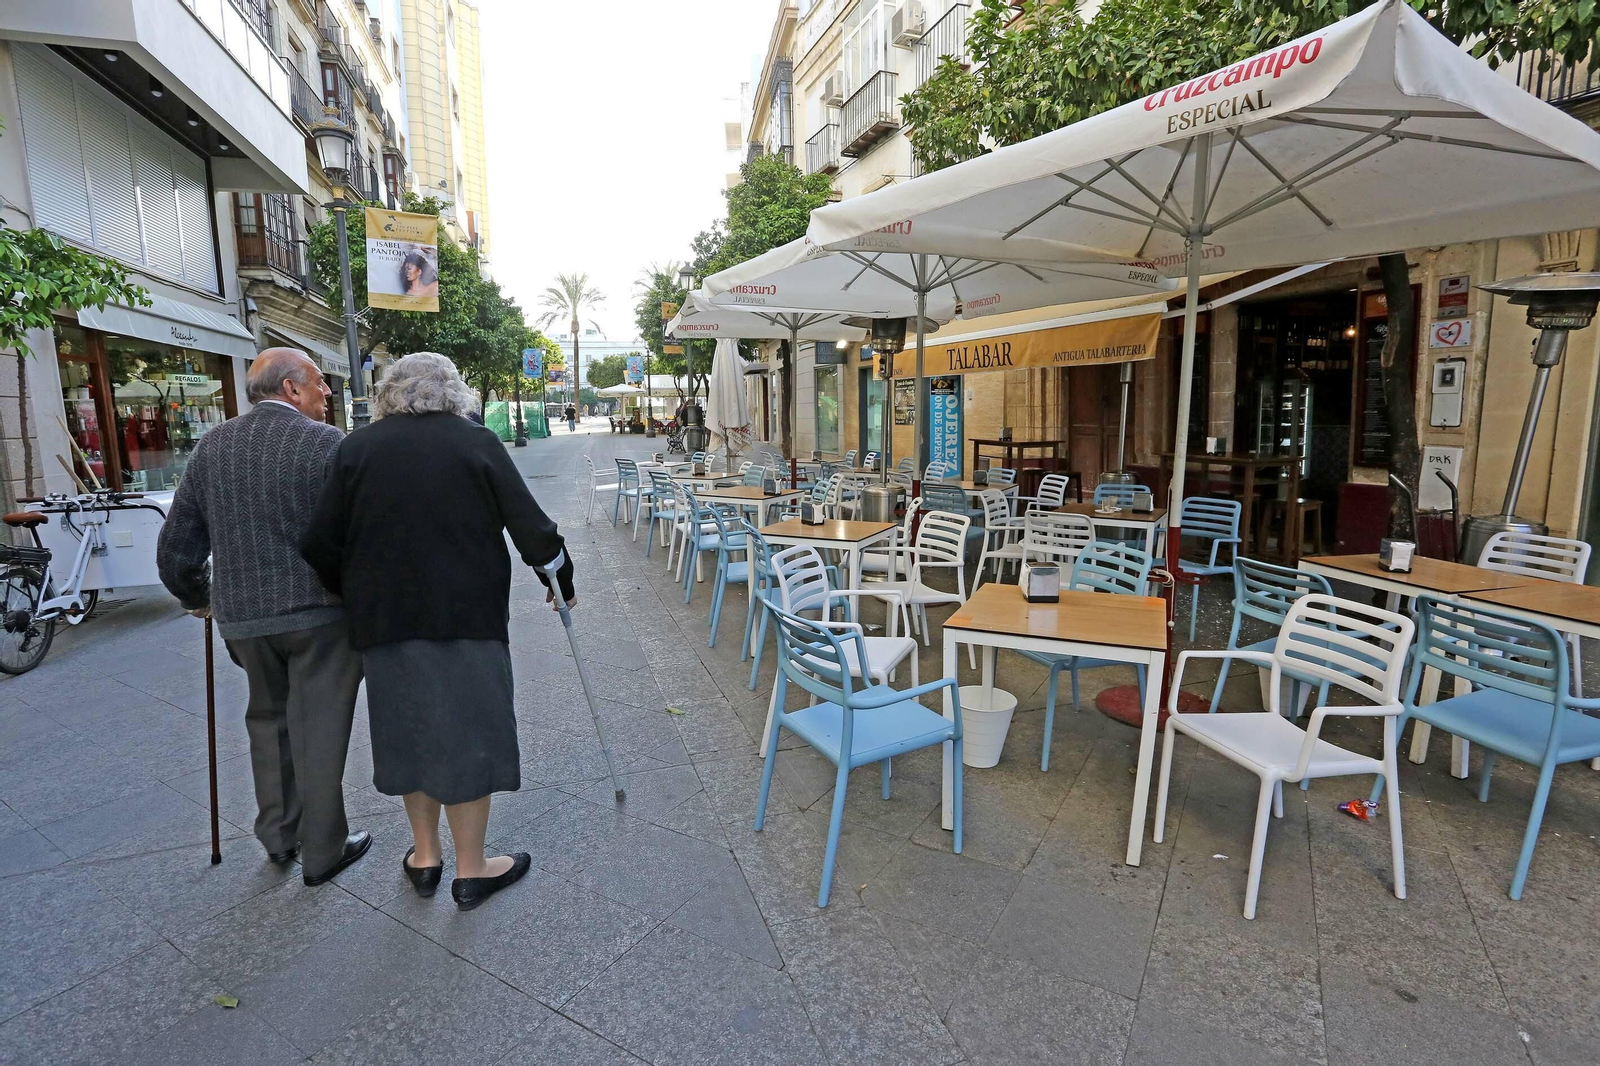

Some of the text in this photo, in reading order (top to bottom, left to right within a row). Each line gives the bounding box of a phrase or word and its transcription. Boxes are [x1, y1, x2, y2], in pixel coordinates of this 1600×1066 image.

[1167, 89, 1272, 135] ESPECIAL
[376, 240, 401, 249] ISABEL
[371, 247, 407, 257] PANTOJA
[1127, 270, 1159, 284] ESPECIAL
[946, 341, 1014, 371] TALABAR
[1052, 344, 1148, 362] ANTIGUA TALABARTERIA
[174, 375, 201, 383] REGALOS
[1429, 455, 1451, 464] DRK
